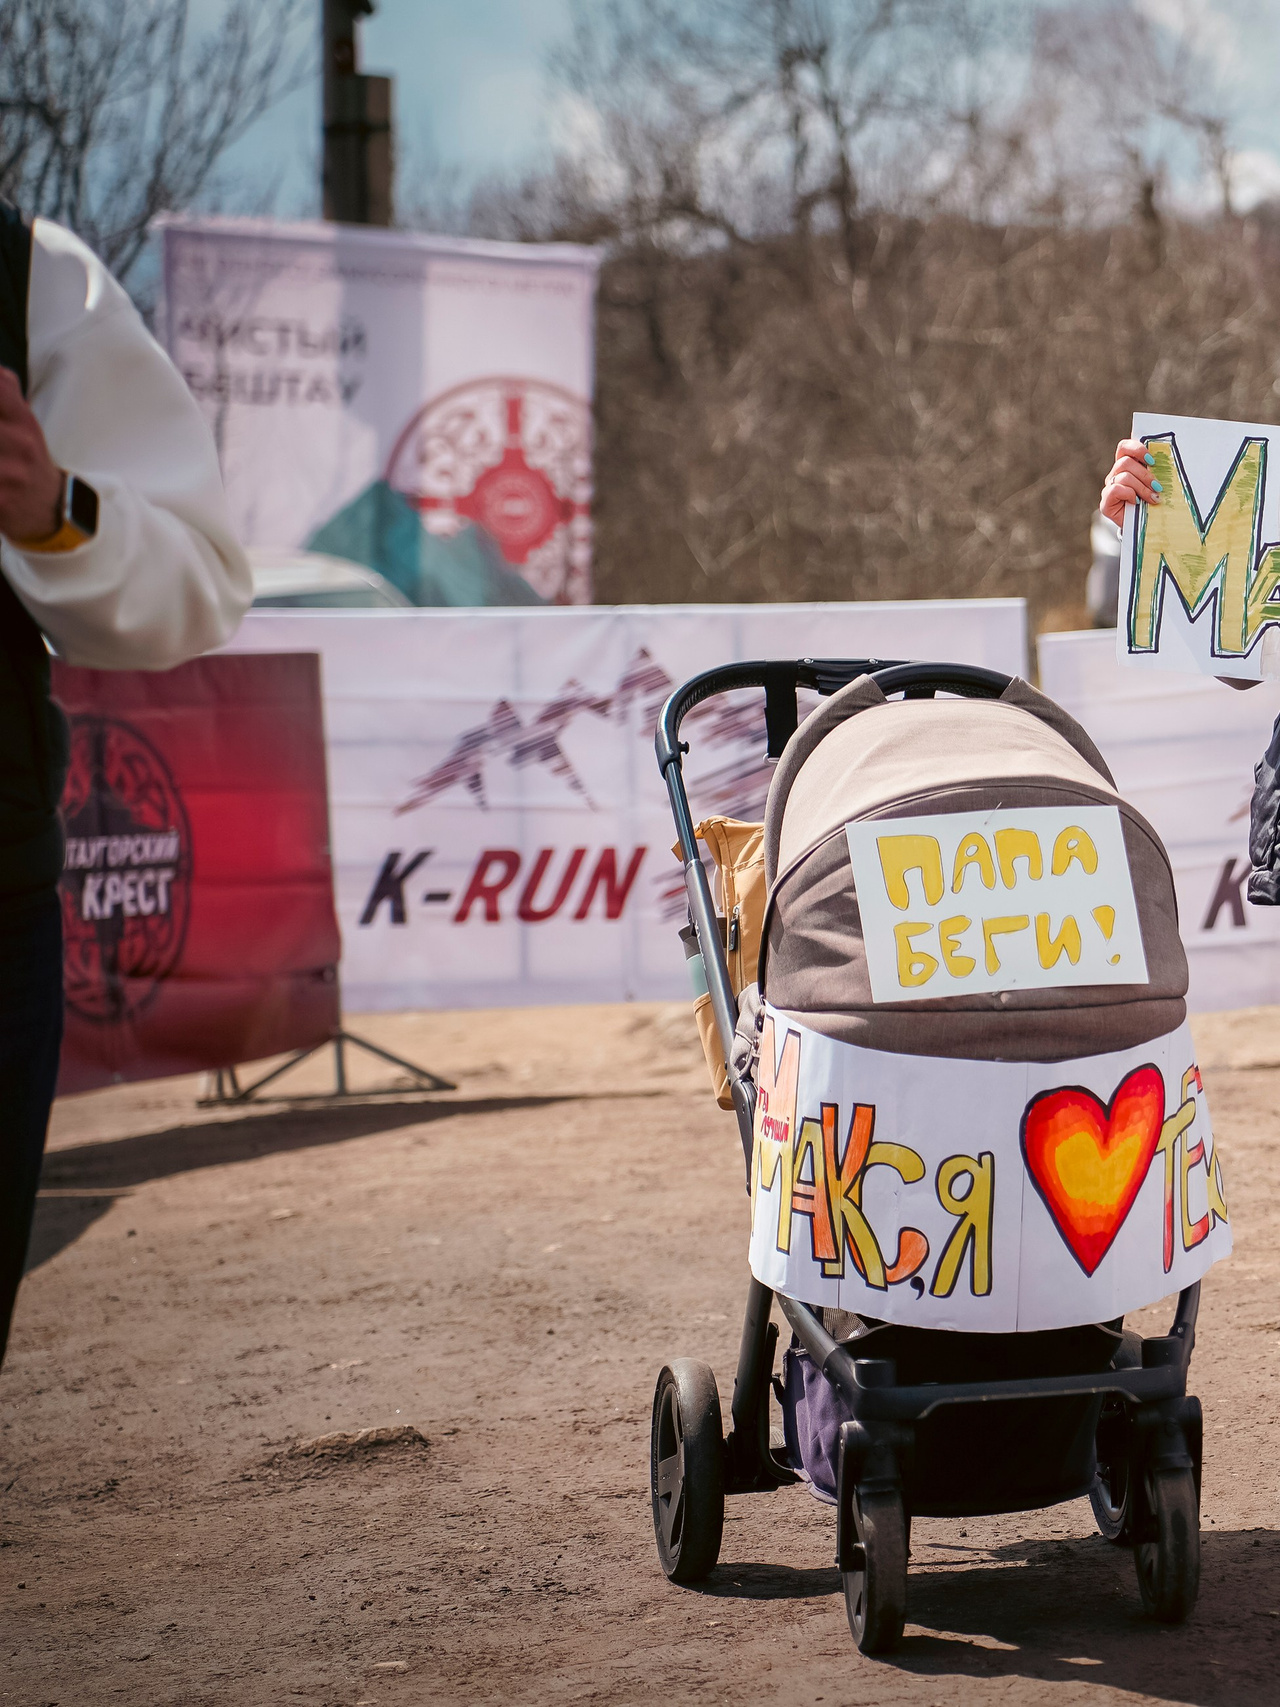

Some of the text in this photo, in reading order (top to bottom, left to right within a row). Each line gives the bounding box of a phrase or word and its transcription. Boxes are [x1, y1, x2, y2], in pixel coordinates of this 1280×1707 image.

[178, 314, 368, 359] ЧИСТЫЙ
[183, 367, 364, 406] БЕШТАУ
[64, 825, 180, 870] ТАУГОРСКИЙ
[876, 825, 1098, 911] ПАПА
[82, 867, 176, 921] КРЕСТ
[359, 846, 647, 926] K-RUN
[894, 905, 1121, 988] БЕГИ!
[929, 1150, 995, 1299] Я
